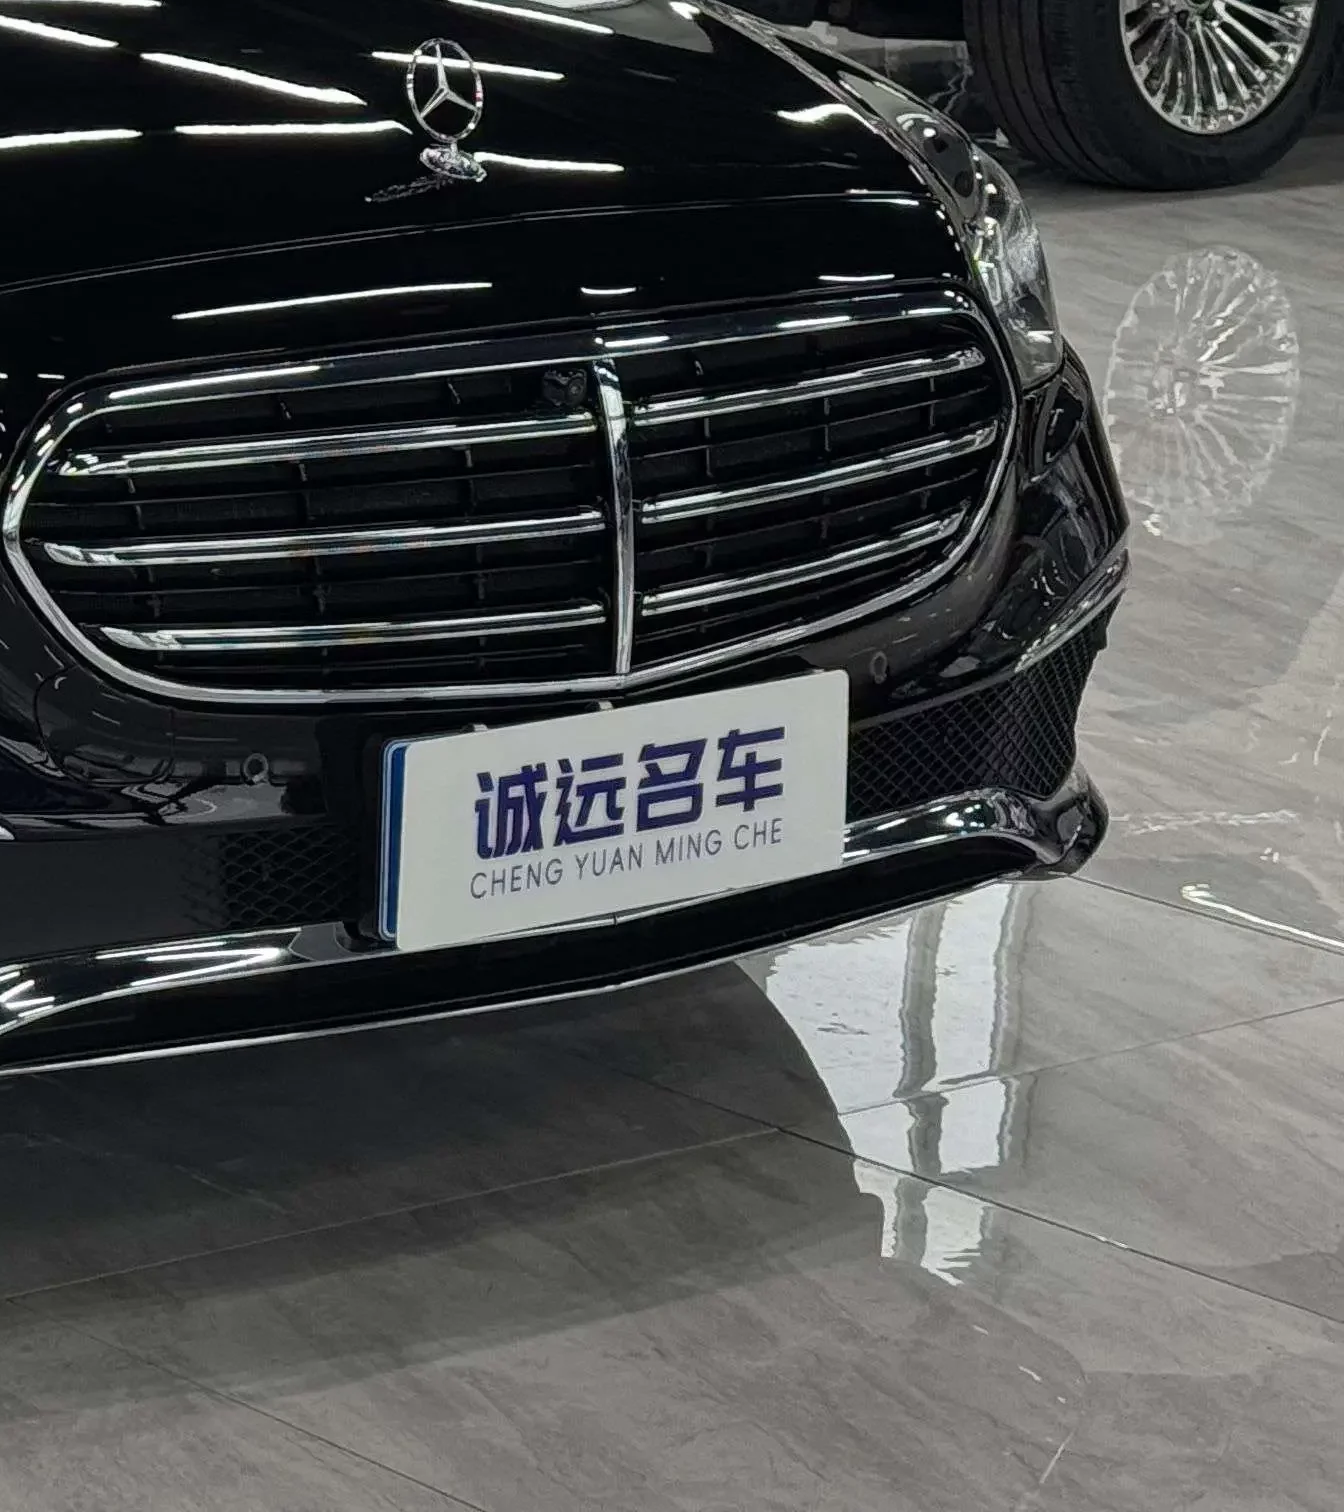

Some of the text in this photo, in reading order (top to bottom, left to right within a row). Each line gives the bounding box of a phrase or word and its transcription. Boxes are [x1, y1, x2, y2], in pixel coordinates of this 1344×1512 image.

[473, 726, 786, 860] 诚远名车
[470, 818, 784, 900] CHENG YUAN MING CHE
